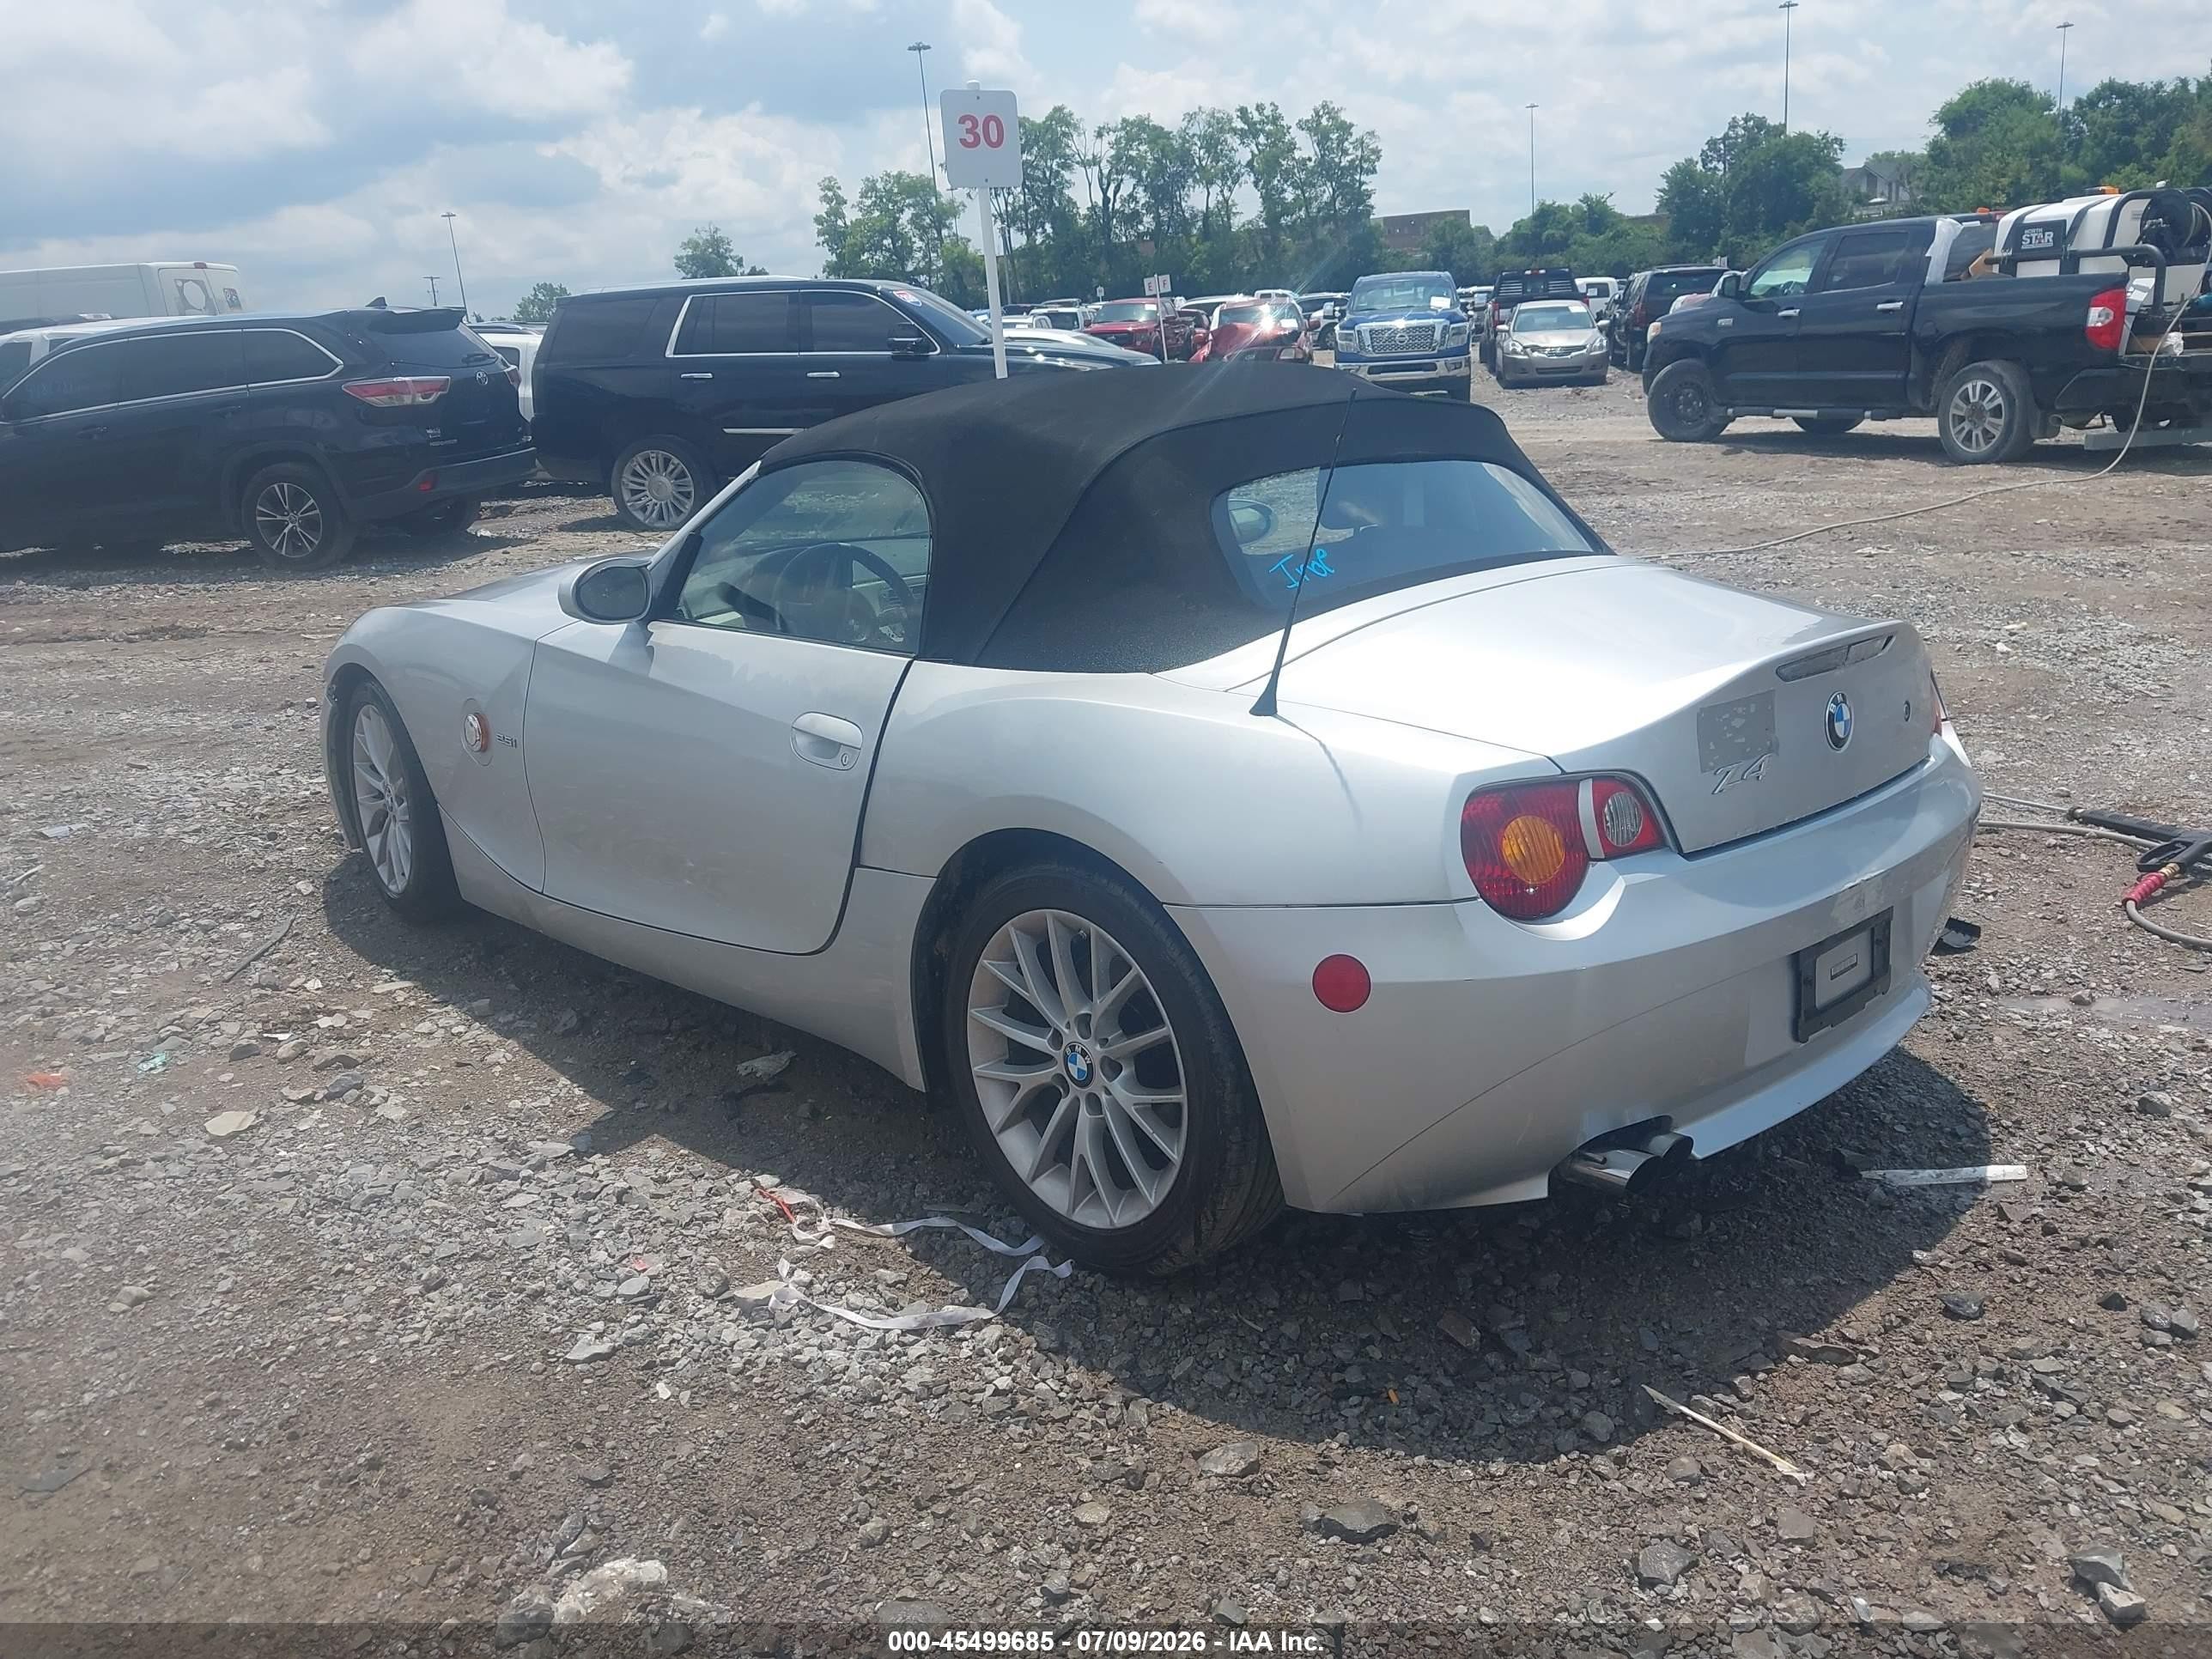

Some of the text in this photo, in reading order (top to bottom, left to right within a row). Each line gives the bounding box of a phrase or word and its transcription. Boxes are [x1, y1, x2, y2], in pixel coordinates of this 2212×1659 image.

[957, 113, 1005, 149] 30
[2021, 231, 2054, 246] STAR
[1147, 282, 1153, 291] E
[1162, 279, 1168, 289] F
[1711, 752, 1774, 795] Z4
[1065, 1044, 1092, 1065] BMW
